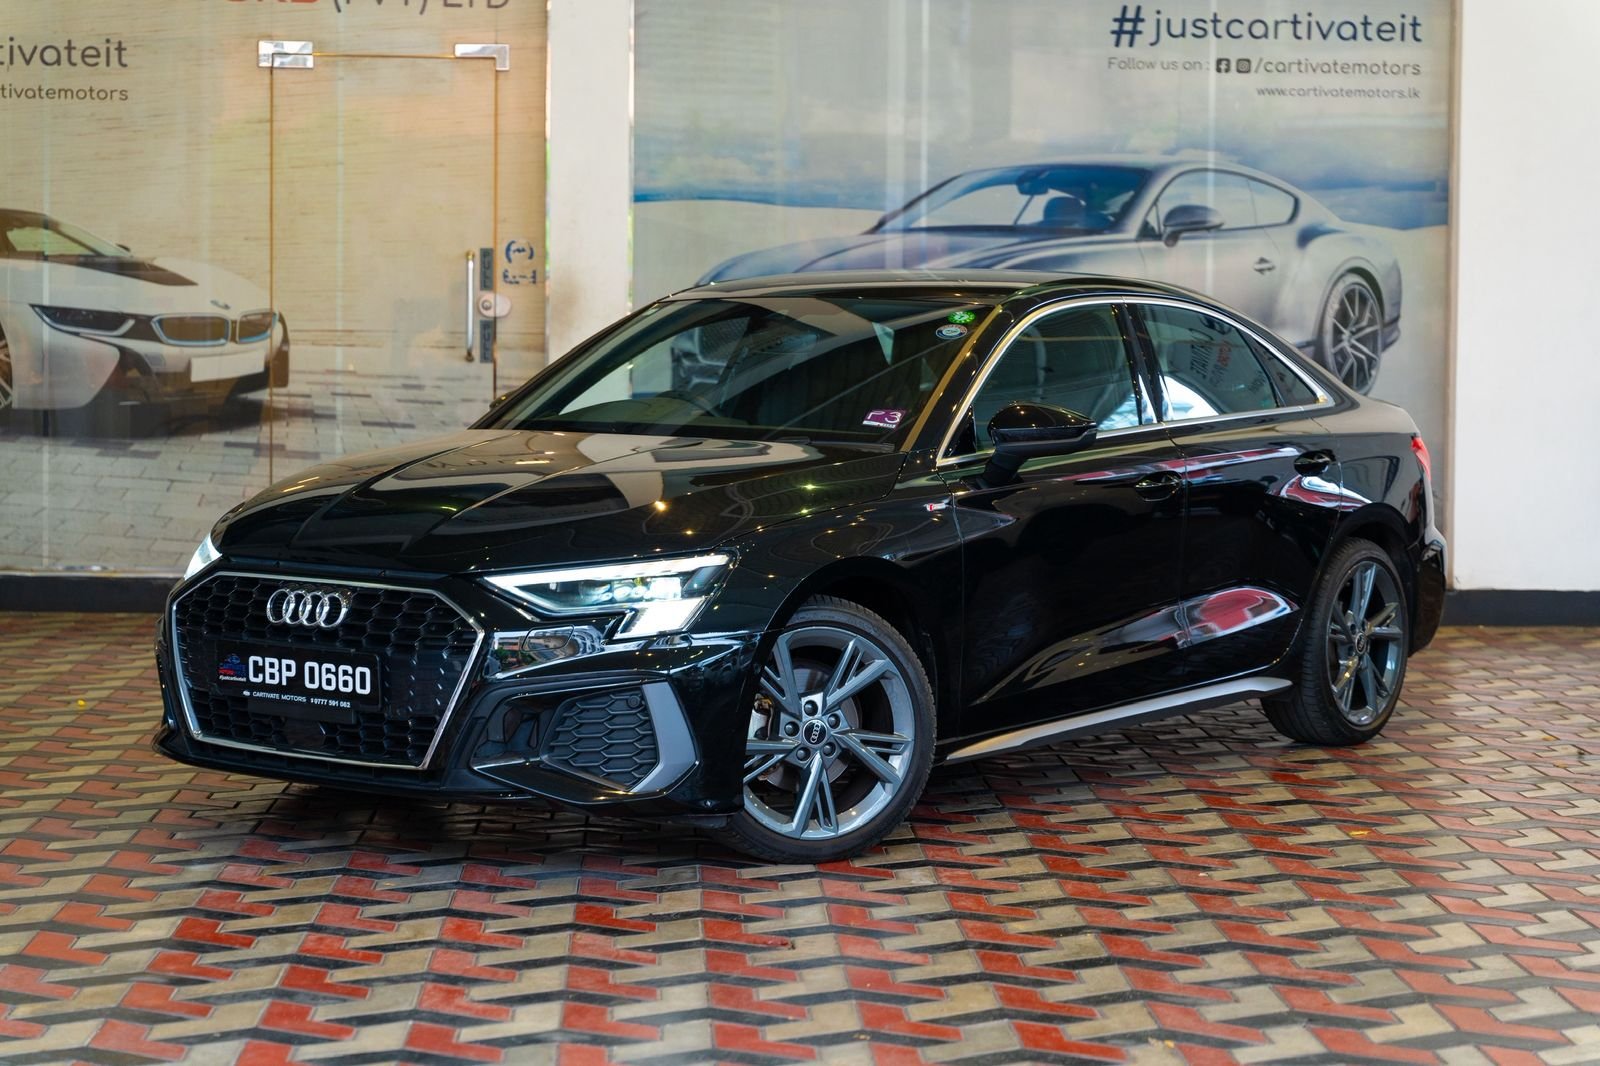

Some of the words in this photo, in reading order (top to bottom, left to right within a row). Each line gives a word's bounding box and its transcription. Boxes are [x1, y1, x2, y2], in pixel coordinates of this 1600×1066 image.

[1110, 4, 1423, 48] #justcartivateit
[1107, 56, 1155, 71] Follow
[1160, 60, 1179, 71] us
[1256, 85, 1421, 99] www.cartivatemotors.lk
[248, 655, 296, 686] CBP
[304, 661, 371, 695] 0660
[252, 691, 280, 700] CARTIVATE
[281, 694, 307, 703] MOTORS
